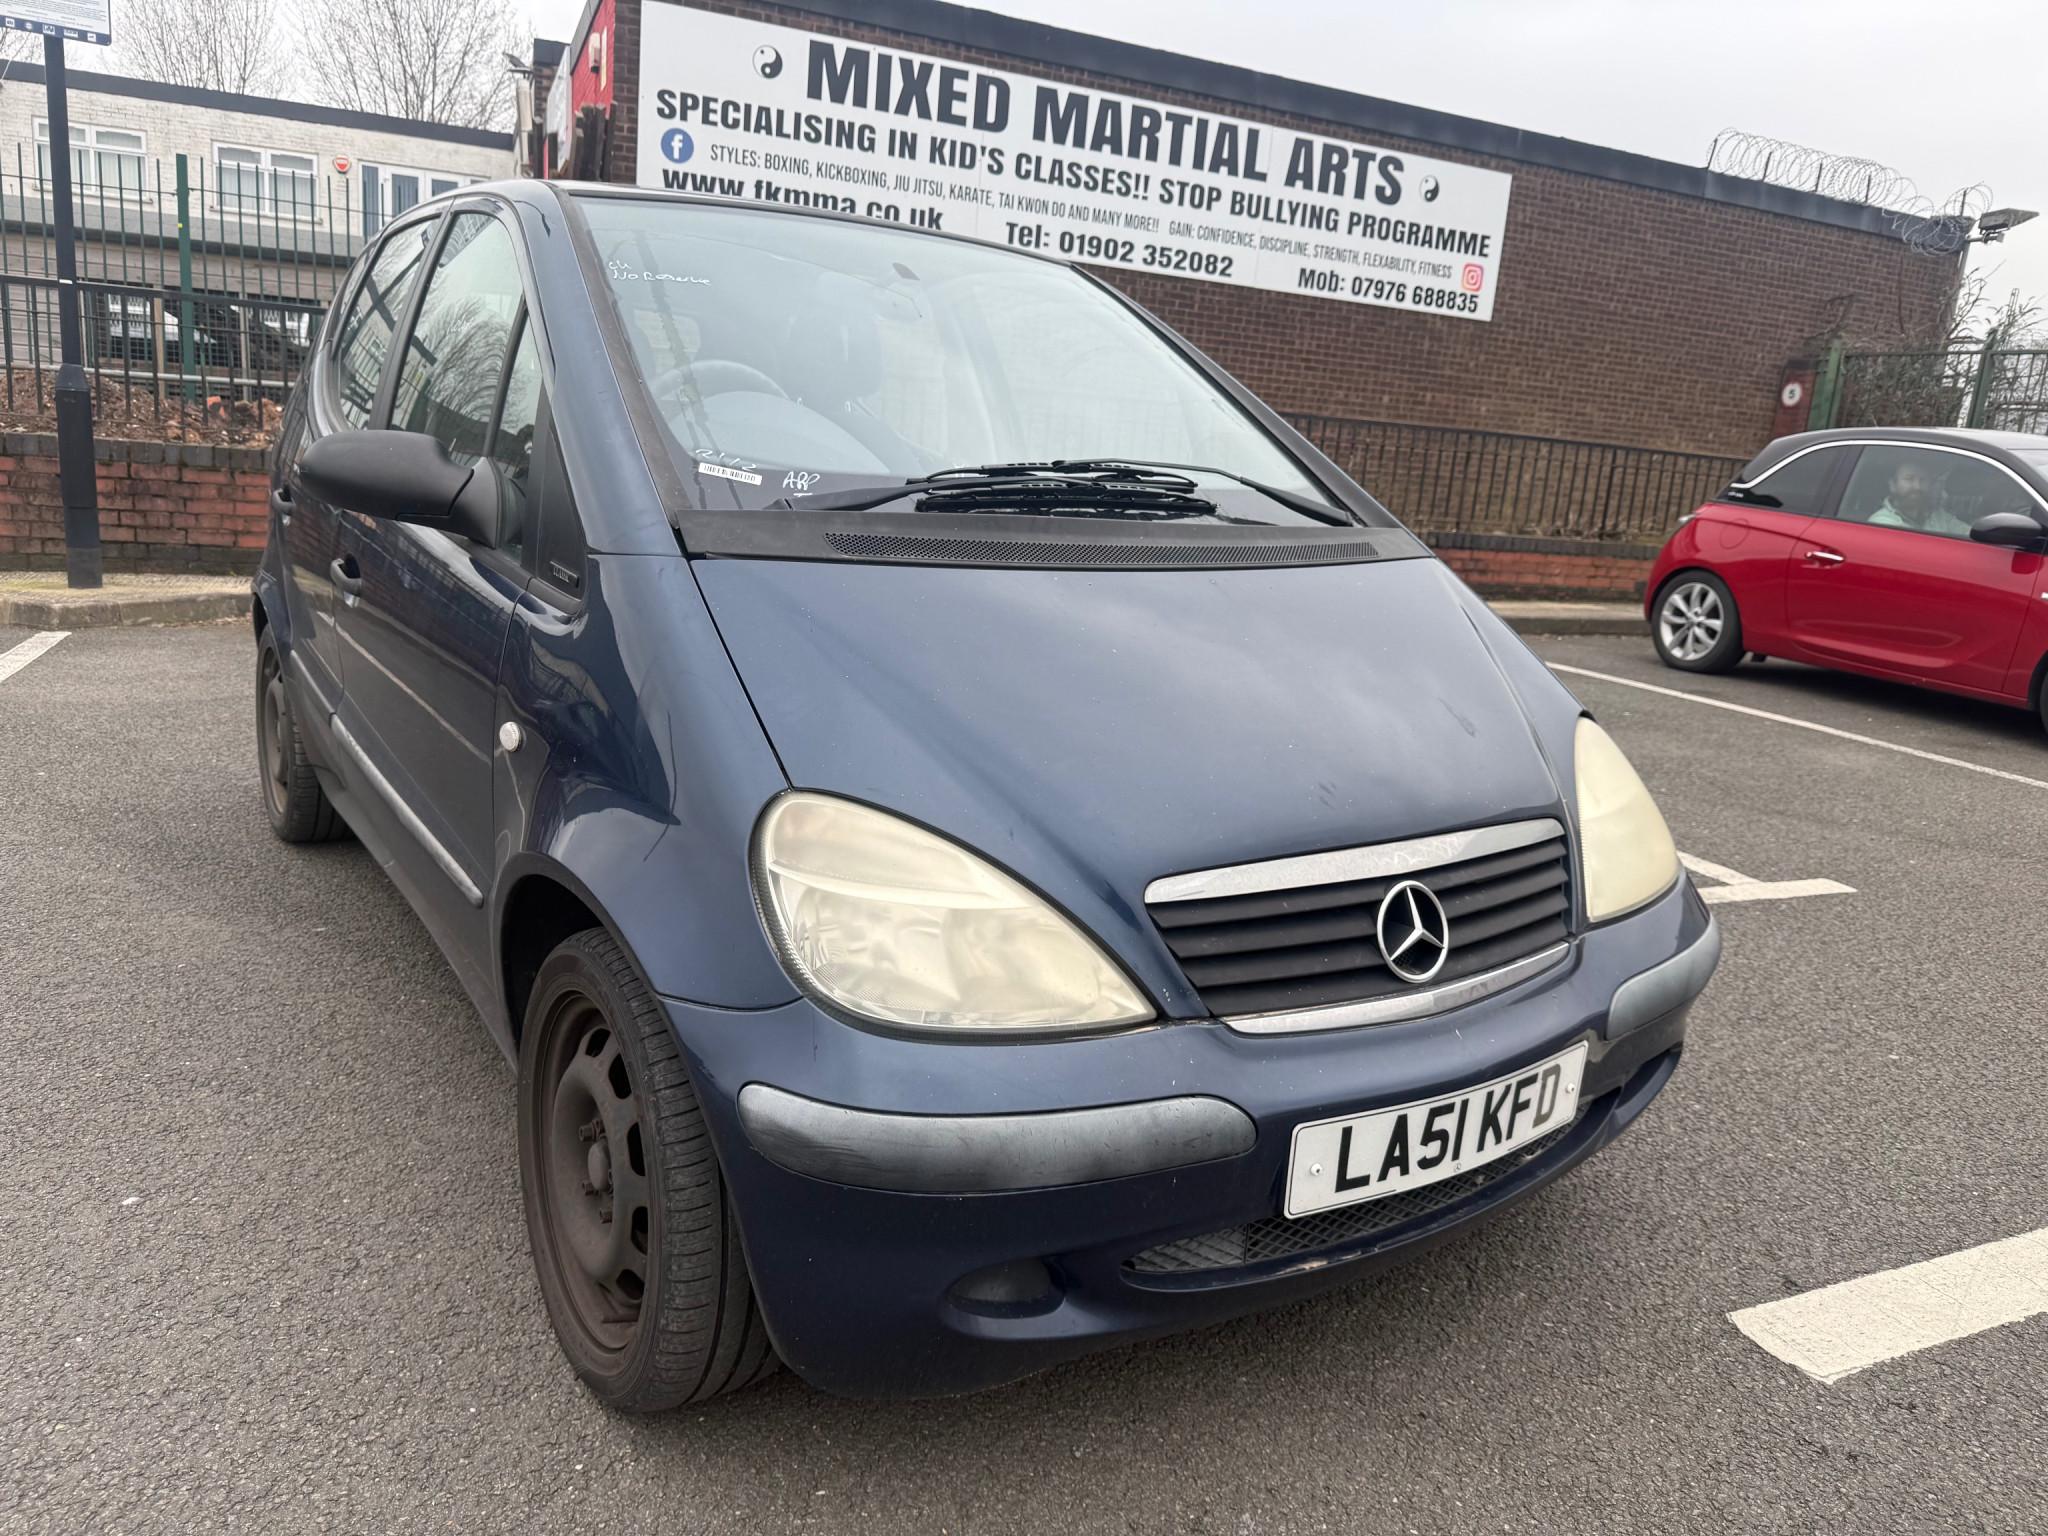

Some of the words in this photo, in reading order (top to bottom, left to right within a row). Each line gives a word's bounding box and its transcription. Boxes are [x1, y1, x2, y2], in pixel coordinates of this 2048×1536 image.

[656, 88, 877, 154] SPECIALISING
[888, 128, 918, 161] IN
[929, 135, 1005, 176] KID'S
[1014, 152, 1151, 201] CLASSES!!
[1158, 178, 1222, 212] STOP
[1230, 190, 1340, 233] BULLYING
[1347, 211, 1491, 258] PROGRAMME
[806, 39, 1011, 134] MIXED
[1032, 86, 1268, 183] MARTIAL
[1284, 136, 1405, 206] ARTS
[710, 144, 761, 168] STYLES:
[764, 152, 813, 179] BOXING,
[816, 160, 890, 192] KICKBOXING,
[893, 174, 911, 193] JIU
[913, 177, 946, 200] JITSU,
[949, 183, 995, 207] KARATE,
[999, 191, 1014, 209] TAI
[1017, 195, 1050, 217] KWON
[1051, 201, 1066, 218] DO
[1068, 204, 1090, 222] AND
[1091, 207, 1123, 227] MANY
[1123, 212, 1160, 233] MORE!!
[1168, 220, 1196, 239] GAIN:
[1197, 225, 1257, 249] CONFIDENCE,
[1259, 235, 1311, 259] DISCIPLINE,
[1312, 244, 1361, 266] STRENGTH,
[1363, 251, 1417, 275] FLEXABILITY,
[1418, 261, 1453, 279] FITNESS
[1005, 221, 1051, 249] Tel:
[1059, 230, 1135, 263] 01902
[1142, 244, 1234, 278] 352082
[1297, 267, 1346, 293] Mob:
[1351, 275, 1407, 302] 07976
[1412, 285, 1480, 314] 688835
